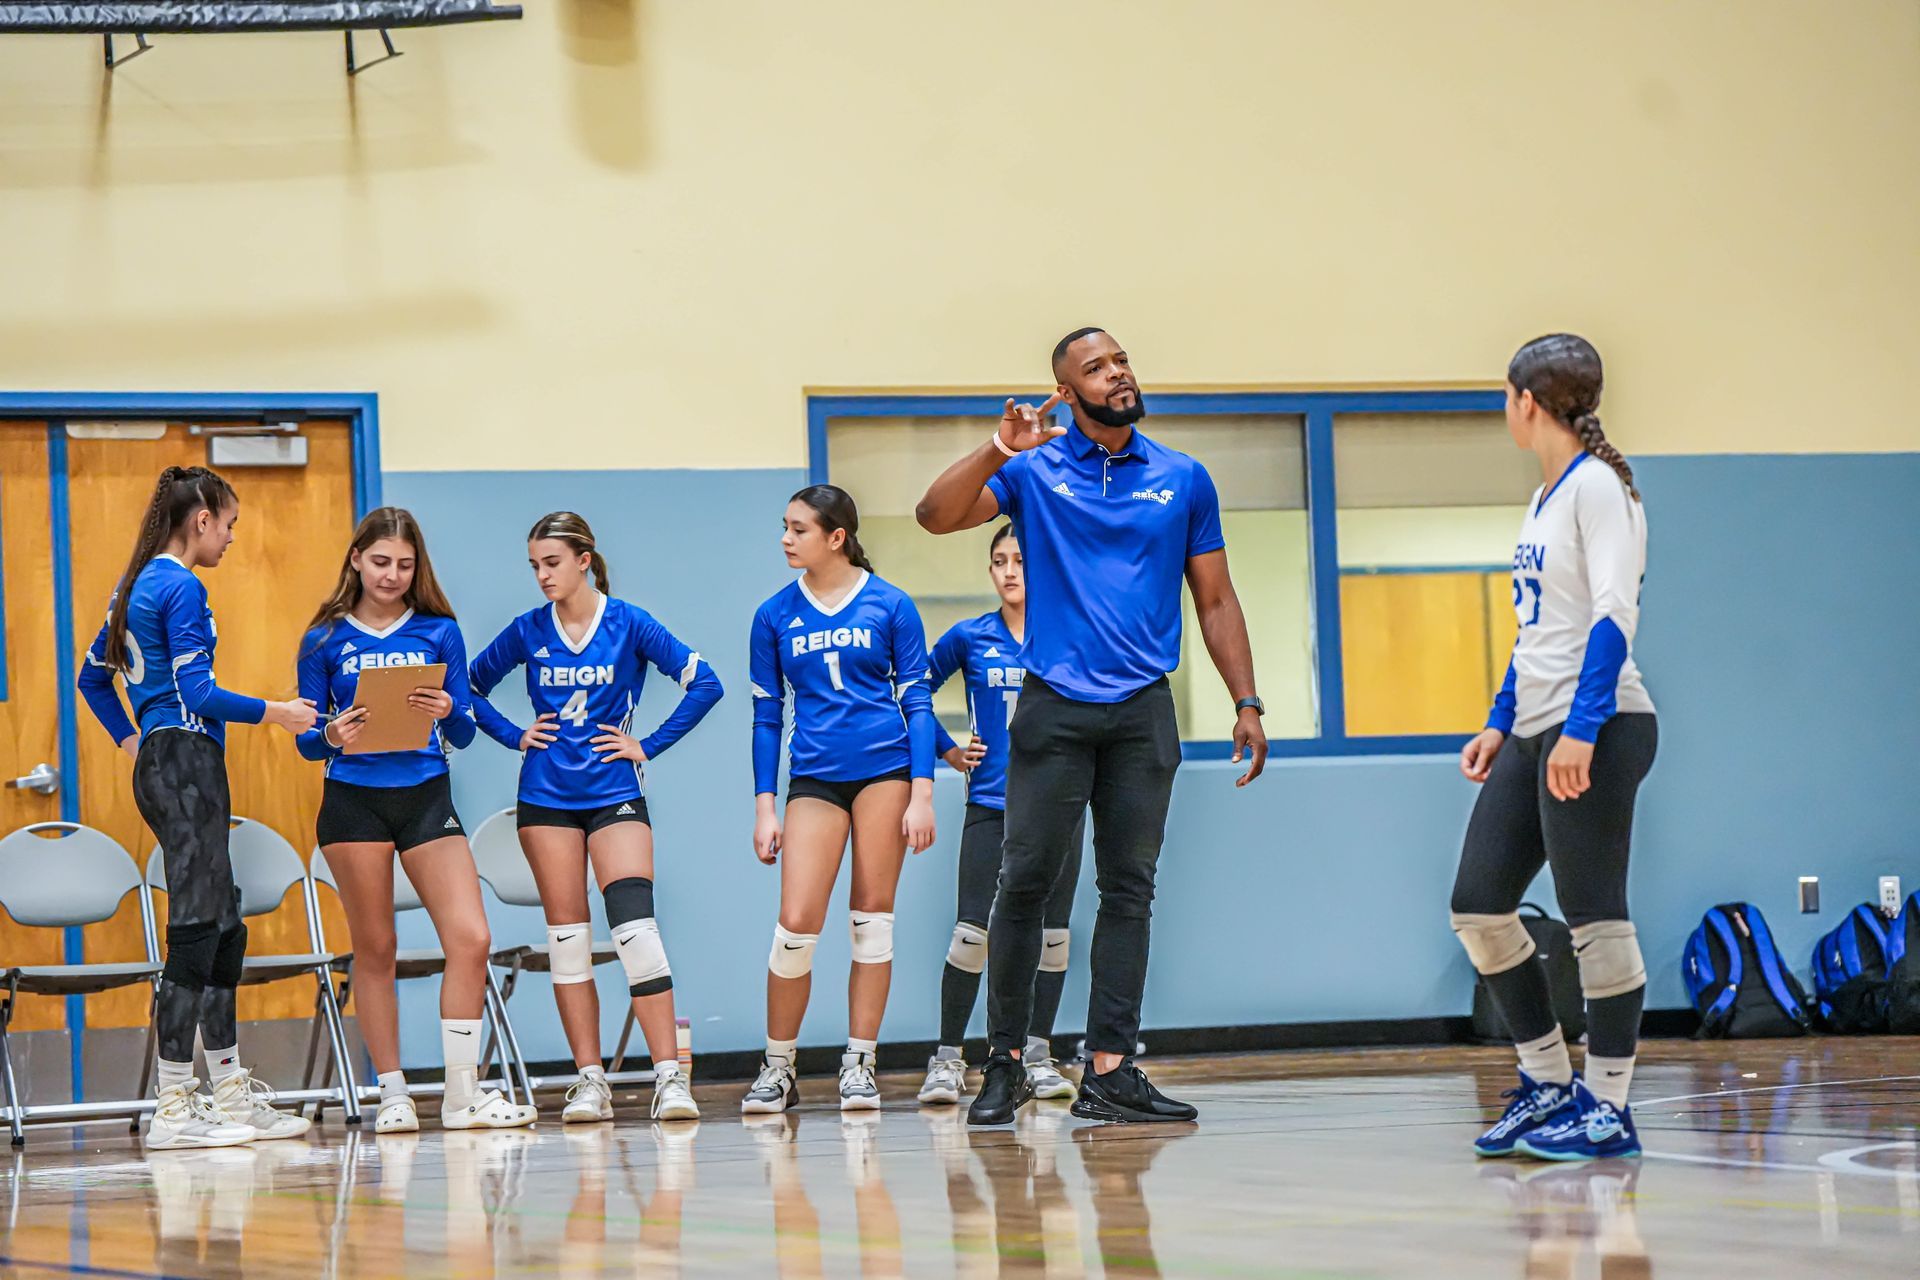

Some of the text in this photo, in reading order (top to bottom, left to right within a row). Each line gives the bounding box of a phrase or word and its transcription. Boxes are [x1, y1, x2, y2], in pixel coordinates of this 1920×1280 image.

[1513, 544, 1545, 571] EIGN
[792, 627, 871, 657] REIGN
[342, 652, 426, 676] REIGN
[539, 664, 614, 687] REIGN
[823, 651, 845, 691] 1
[560, 690, 588, 727] 4
